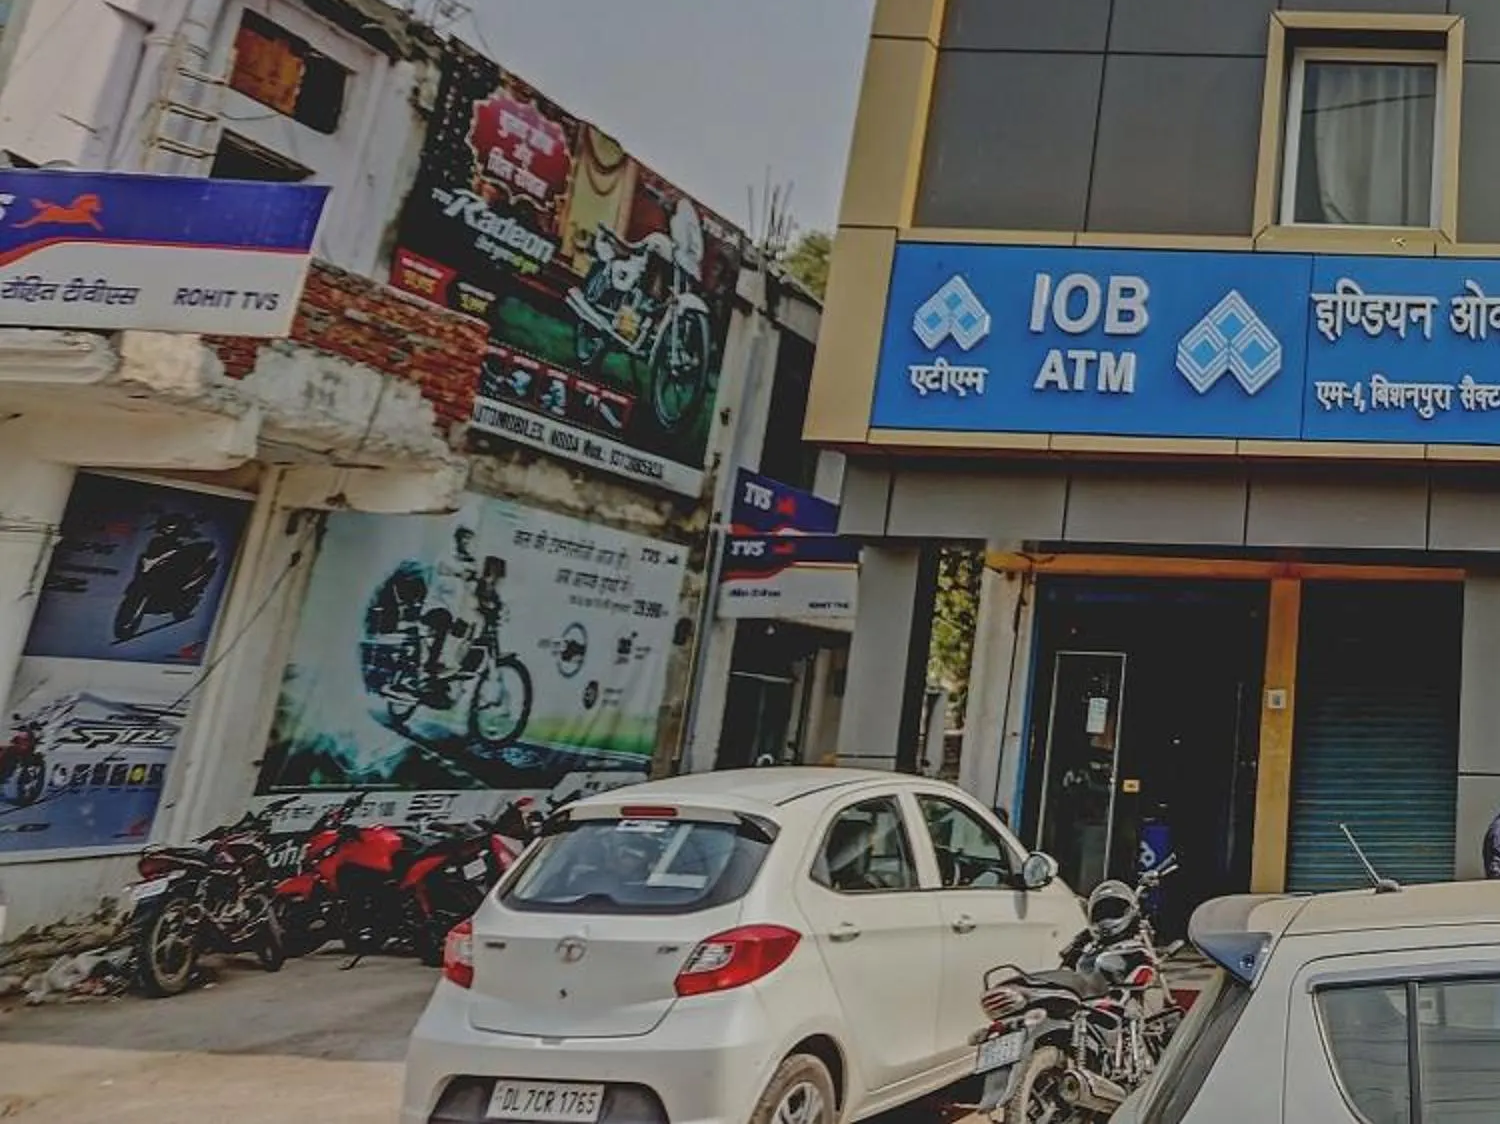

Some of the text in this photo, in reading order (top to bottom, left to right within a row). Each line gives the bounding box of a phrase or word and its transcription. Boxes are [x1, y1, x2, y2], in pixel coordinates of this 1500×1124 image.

[174, 287, 281, 311] ROHIT TVS
[1029, 272, 1151, 335] IOB
[908, 357, 989, 396] एटीएम
[1033, 349, 1138, 394] ATM
[743, 481, 773, 511] TVS
[731, 541, 765, 557] TVS
[558, 1091, 598, 1116] 1765
